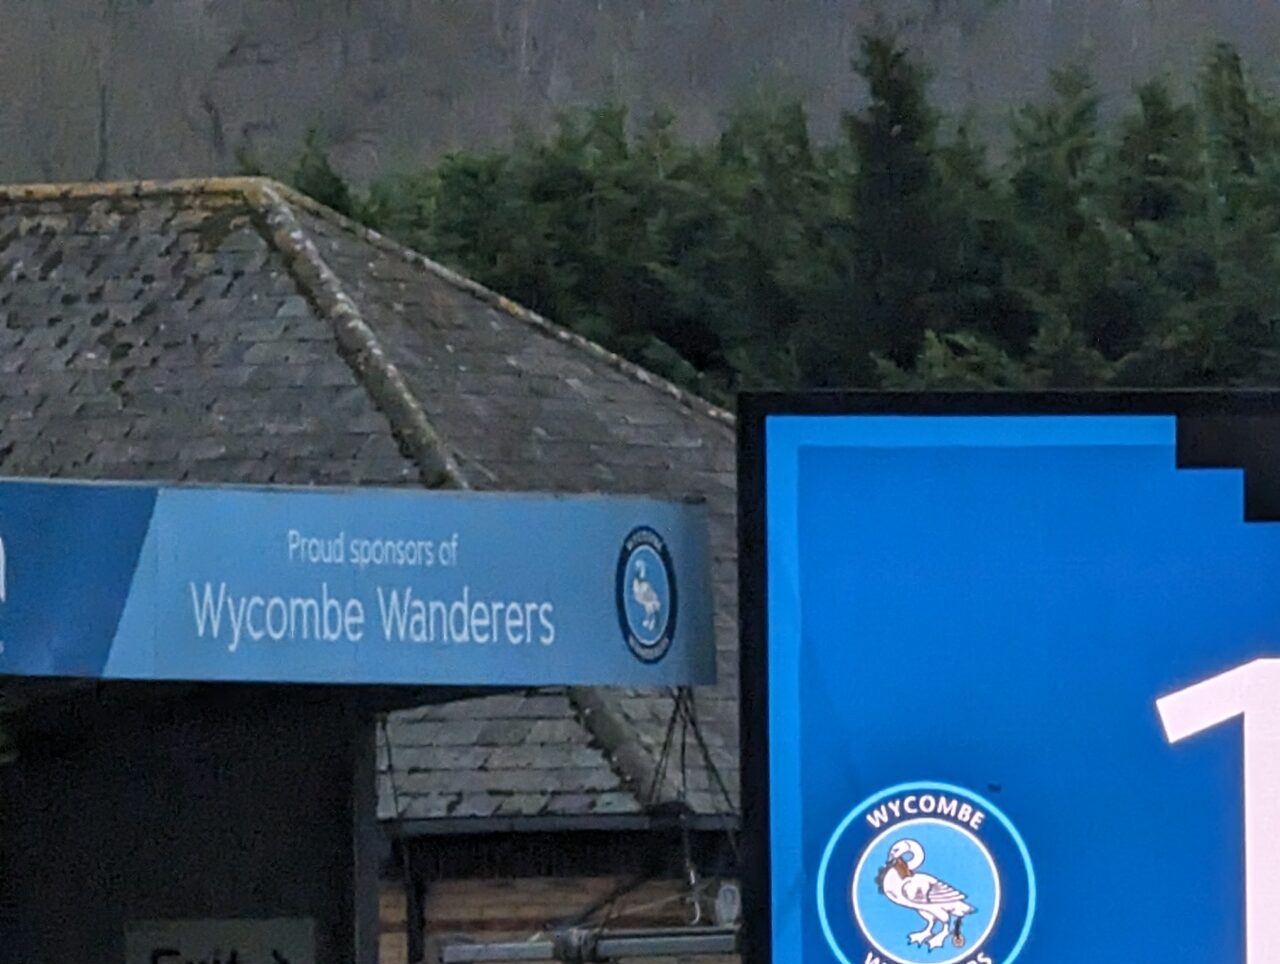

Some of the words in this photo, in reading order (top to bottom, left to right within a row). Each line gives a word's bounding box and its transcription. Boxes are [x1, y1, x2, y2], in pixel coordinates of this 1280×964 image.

[288, 528, 345, 563] Proud
[350, 537, 434, 570] sponsors
[438, 532, 459, 567] of
[189, 581, 365, 652] Wycombe
[376, 584, 556, 646] Wanderers
[865, 794, 985, 830] WYCOMBE
